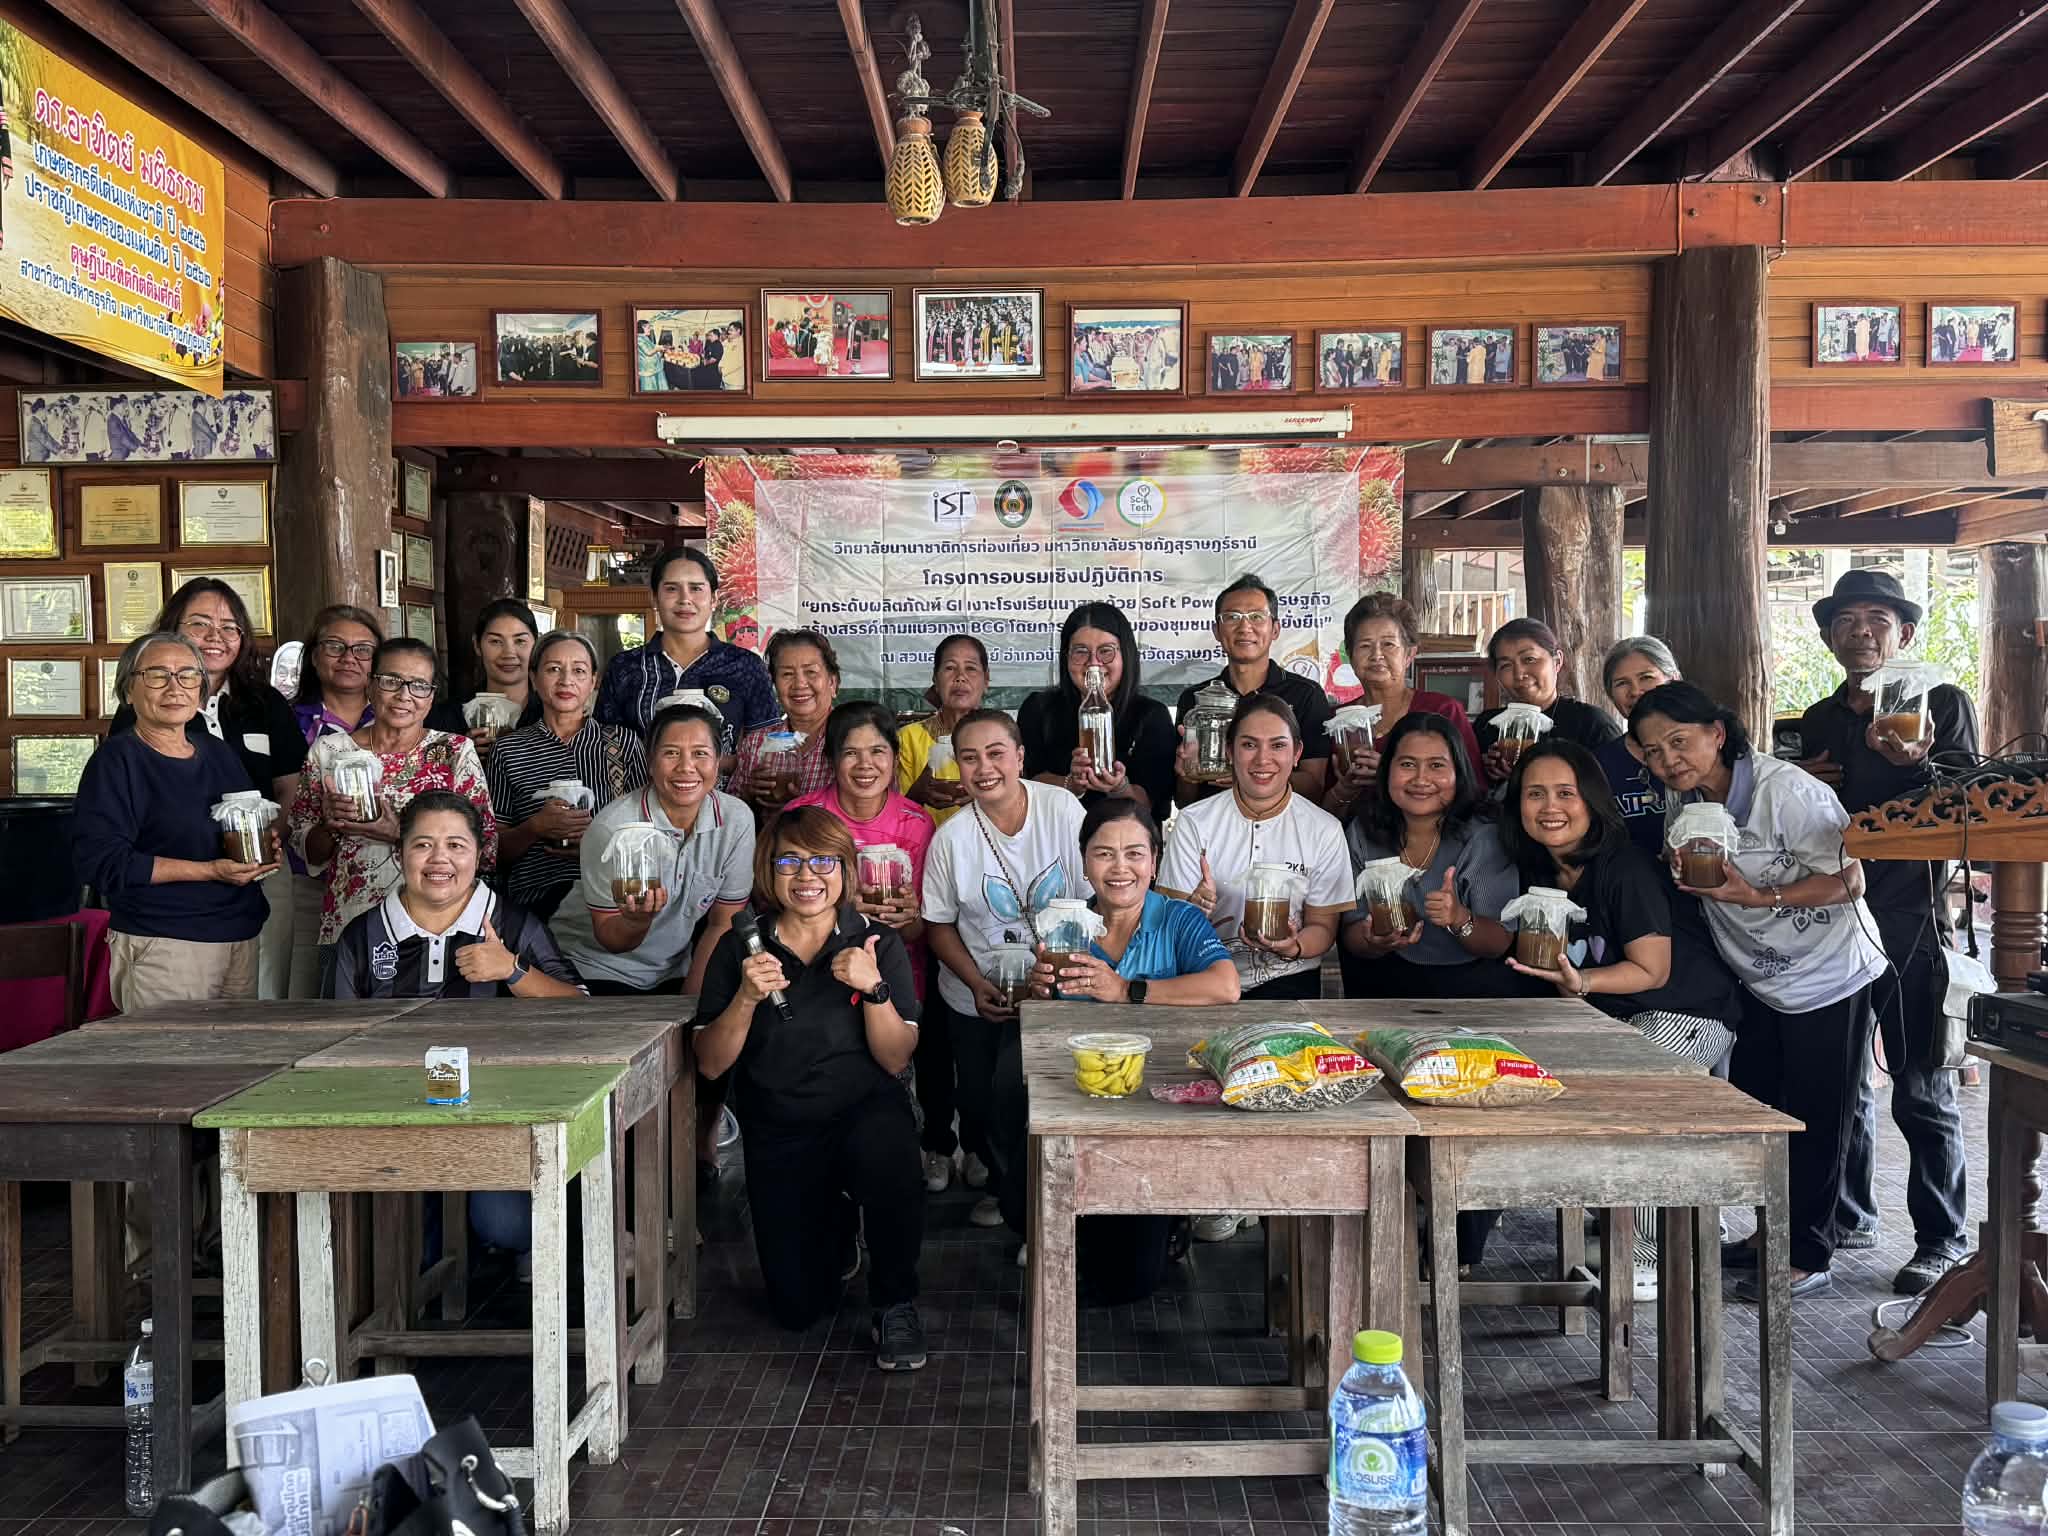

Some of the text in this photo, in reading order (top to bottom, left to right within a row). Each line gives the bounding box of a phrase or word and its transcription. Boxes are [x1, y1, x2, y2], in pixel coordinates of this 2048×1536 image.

[35, 88, 206, 215] ดร.อาทิตย์ มติธรรม
[34, 141, 164, 230] เกษตรกรดีเด่นแห่งชาติ
[167, 207, 177, 236] ปี
[25, 172, 170, 268] ปราชญ์เกษตรของแผ่นดิน
[172, 244, 183, 273] ปี
[20, 259, 117, 318] สาขาวิชาบริหารธุรกิจ
[71, 244, 183, 312] ดุษฎีบัณฑิตกิตติมศักดิ์
[1130, 503, 1152, 512] Tech
[834, 534, 1257, 556] วิทยาลัยนานาชาติการท่องเที่ยว มหาวิทยาลัยราชภัฏสุราษฎร์ธานี
[922, 565, 1163, 588] โครงการอบรมเชิงปฏิบัติการ
[946, 599, 962, 612] GI
[1141, 596, 1177, 609] Soft
[1181, 596, 1214, 609] Pow
[971, 621, 1005, 633] BCG
